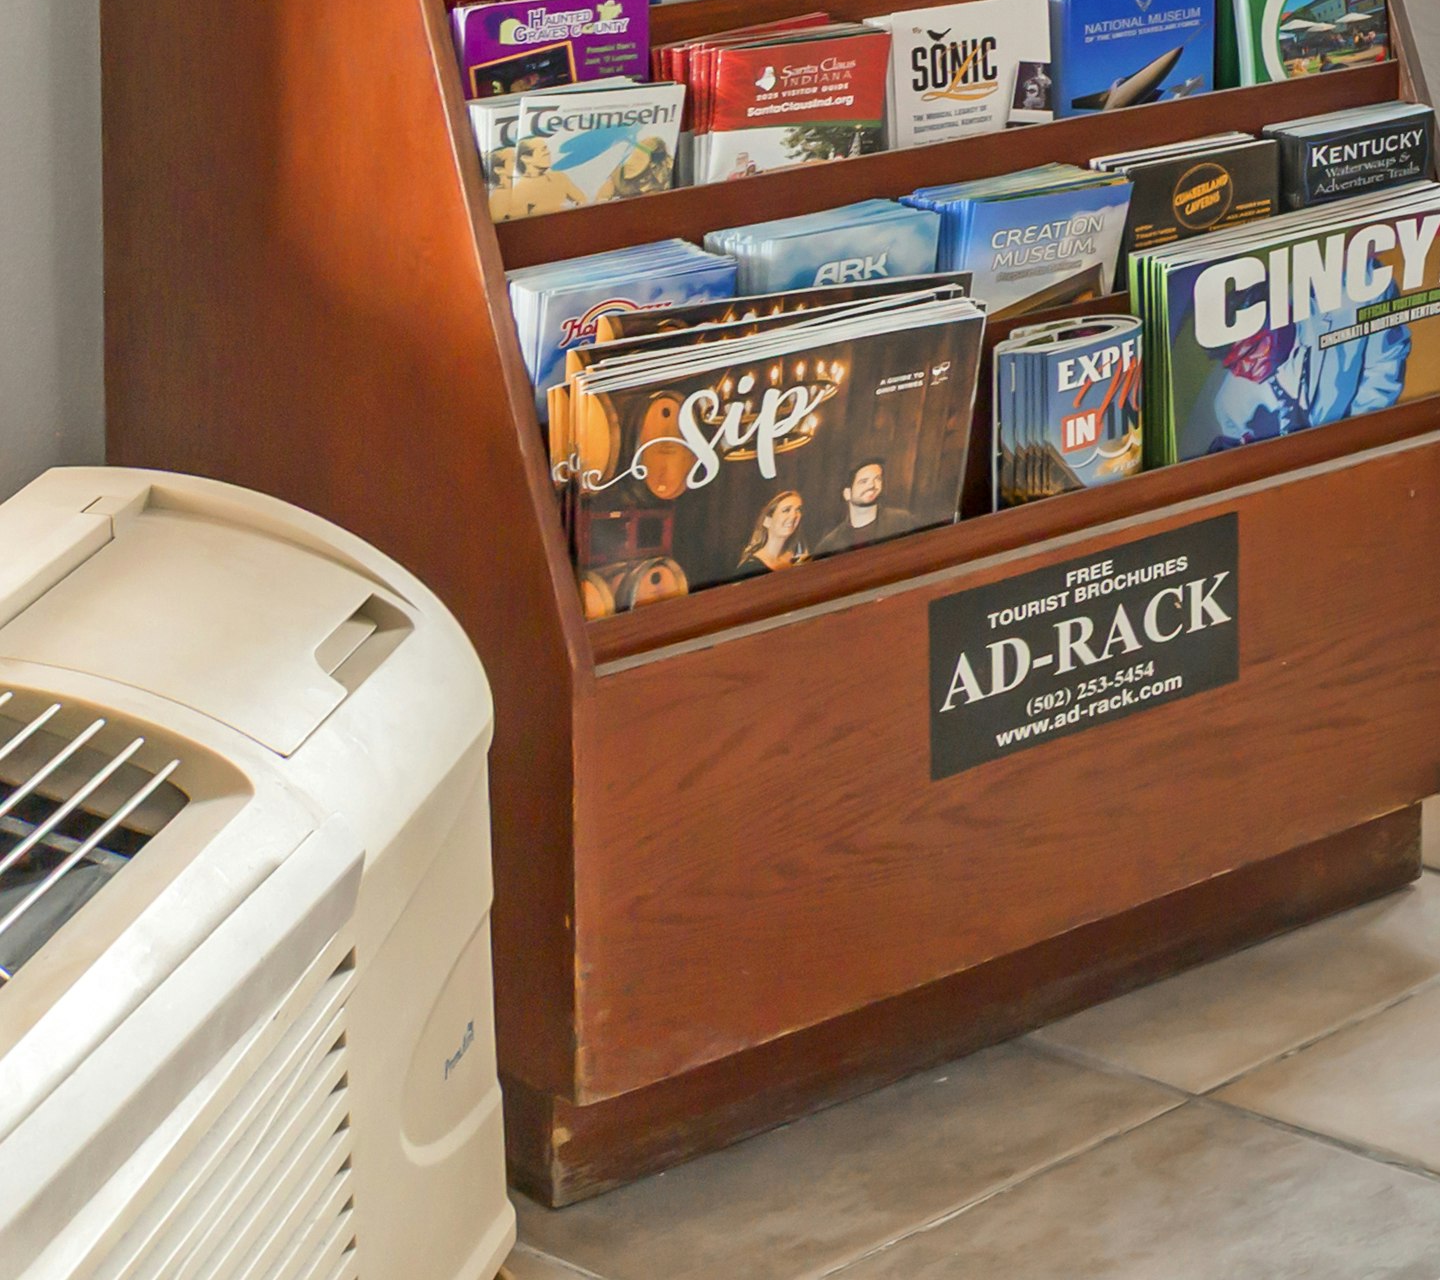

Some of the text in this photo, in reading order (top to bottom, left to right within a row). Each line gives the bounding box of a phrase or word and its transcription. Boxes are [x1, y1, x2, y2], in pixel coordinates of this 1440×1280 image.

[911, 35, 997, 92] SONIC
[525, 103, 677, 138] Tecumseh!
[1310, 128, 1423, 168] KENTUCKY
[677, 374, 838, 490] Sip
[988, 556, 1188, 629] TOURIST BROCHURES
[1066, 559, 1113, 588] FREE
[939, 571, 1231, 712] AD-RACK
[996, 674, 1183, 747] www.ad-rack.com
[1026, 661, 1155, 717] (502) 253-5454
